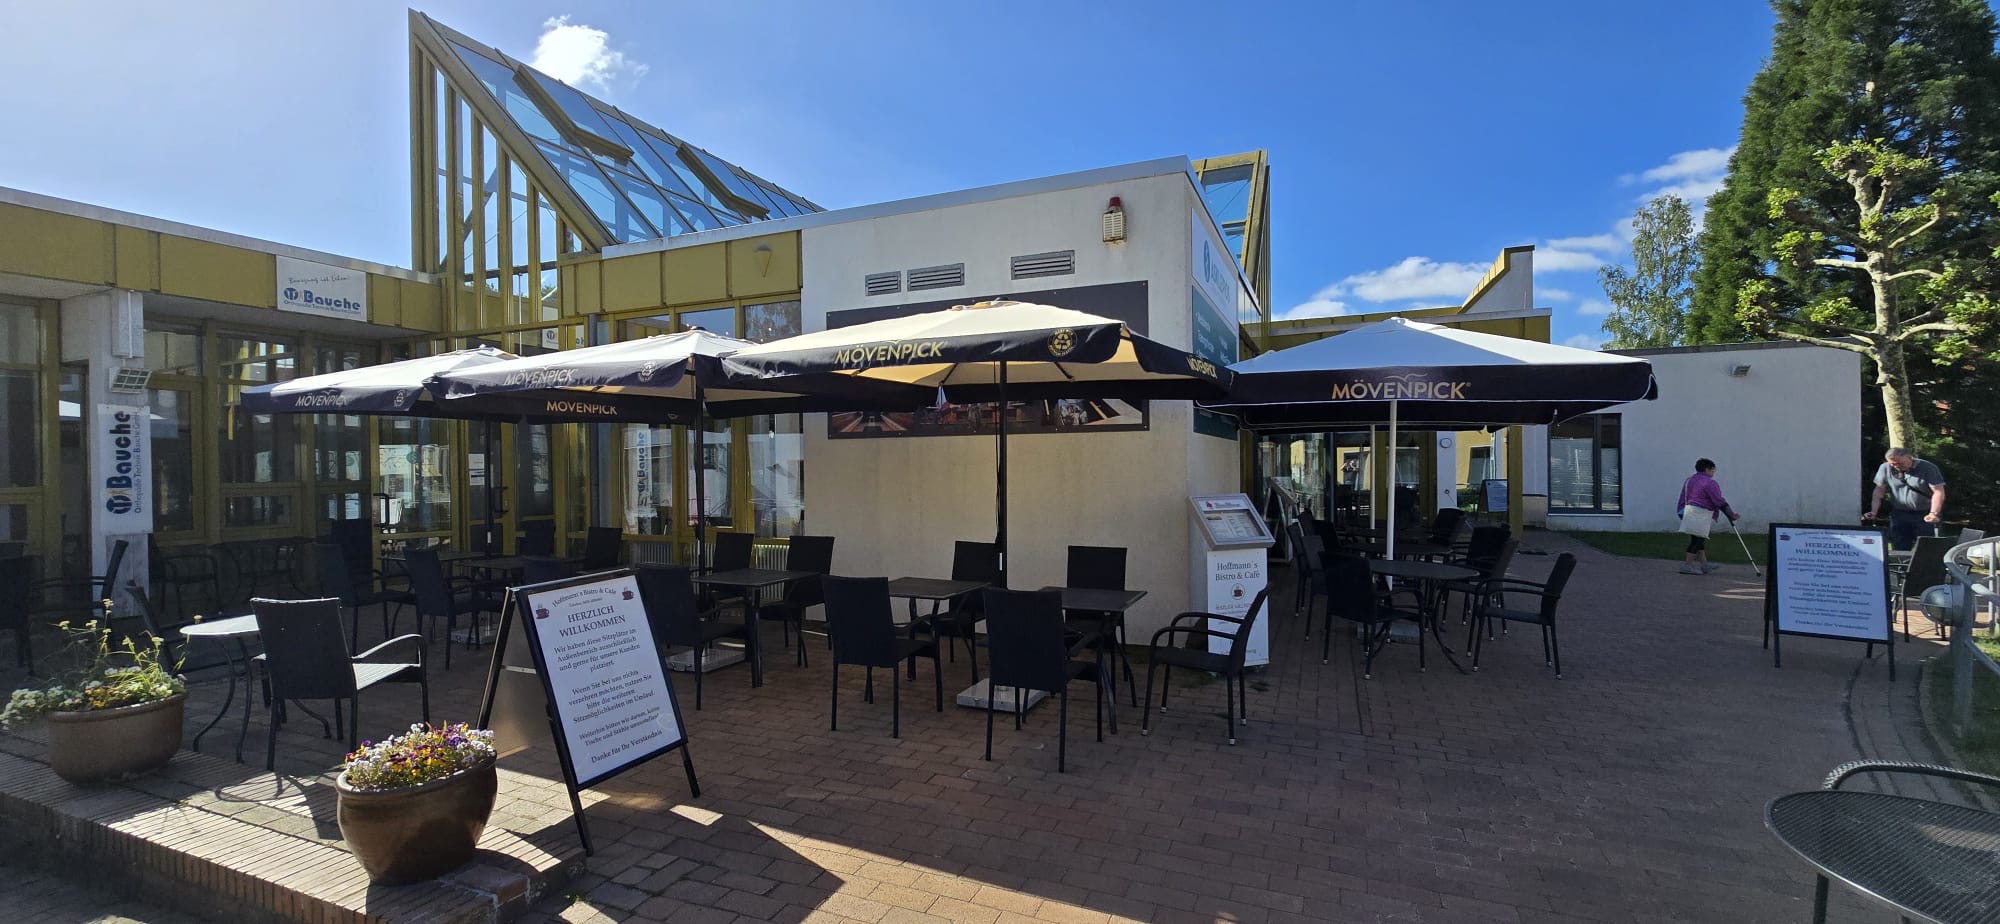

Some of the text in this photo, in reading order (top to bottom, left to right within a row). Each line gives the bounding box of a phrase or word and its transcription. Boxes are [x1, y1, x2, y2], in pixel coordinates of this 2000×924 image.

[303, 289, 360, 310] Bauche
[834, 341, 945, 364] MÖVENPICK
[504, 368, 576, 386] MÖVENPICK
[106, 410, 132, 489] Bauche
[1795, 549, 1860, 557] WILLKOMMEN
[1215, 573, 1236, 581] Bistro
[1237, 572, 1244, 580] &
[567, 605, 614, 623] HERZLICH
[559, 615, 626, 638] WILLKOMMEN
[554, 646, 566, 654] Wir
[568, 641, 586, 651] haben
[586, 638, 601, 646] diese
[559, 662, 572, 671] und
[573, 658, 589, 669] gerne
[572, 685, 591, 695] Wenn
[601, 678, 611, 686] bei
[601, 697, 611, 705] die
[591, 750, 611, 764] Danke
